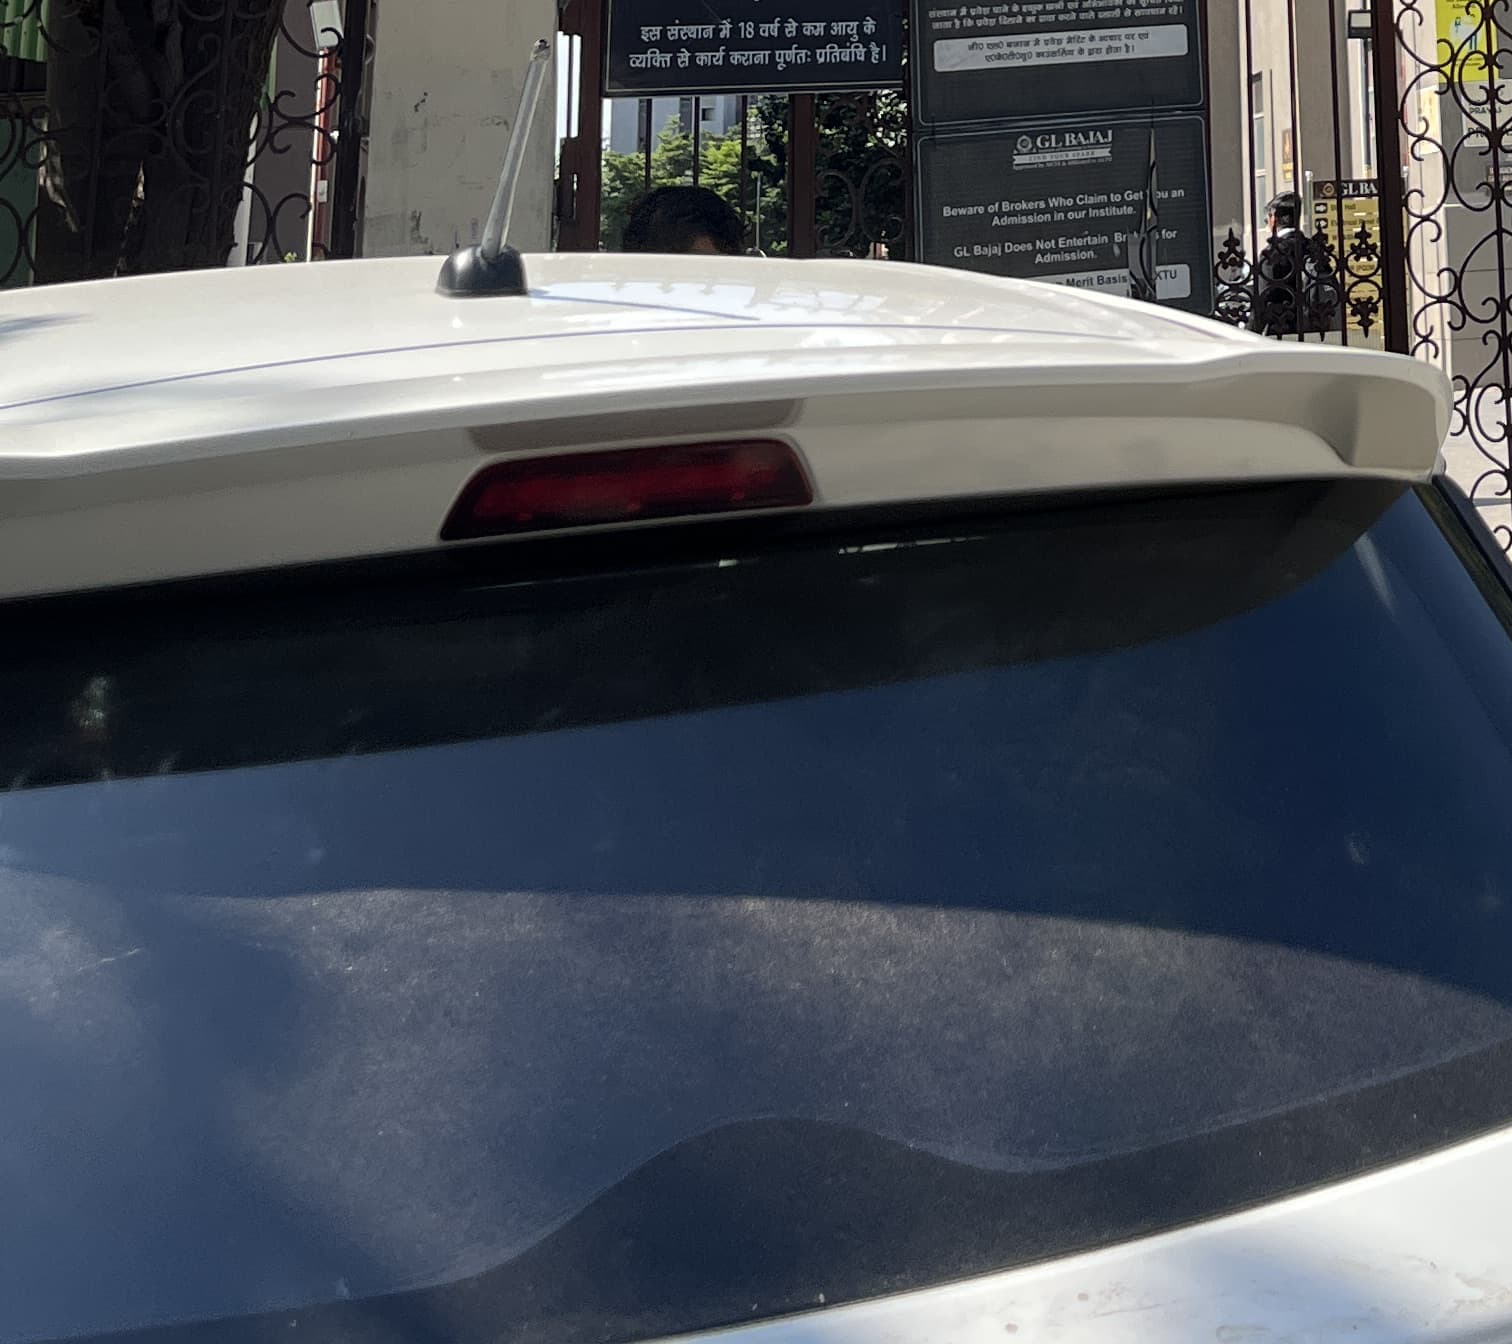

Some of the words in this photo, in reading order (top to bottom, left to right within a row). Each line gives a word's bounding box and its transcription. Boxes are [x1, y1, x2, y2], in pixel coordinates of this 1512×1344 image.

[640, 25, 663, 42] इस
[666, 19, 716, 41] संस्थान
[718, 18, 733, 40] में
[738, 22, 755, 39] 18
[759, 17, 781, 38] वर्ष
[784, 18, 799, 38] से
[802, 22, 826, 37] कम
[830, 20, 859, 41] आयु
[862, 16, 877, 36] के
[629, 48, 673, 69] व्यक्ति
[677, 48, 692, 68] से
[695, 46, 726, 66] कार्य
[729, 51, 770, 65] कराना
[1036, 134, 1062, 148] GL
[1064, 130, 1112, 146] BAJAJ
[943, 202, 984, 217] Beware
[988, 201, 999, 213] of
[1002, 197, 1046, 212] Brokers
[1048, 196, 1074, 209] Who
[1076, 192, 1107, 206] Claim
[1110, 192, 1121, 203] to
[1124, 190, 1143, 202] Get
[1171, 189, 1185, 198] an
[992, 210, 1051, 227] Admission
[1053, 210, 1064, 221] in
[1067, 209, 1086, 220] our
[1088, 204, 1136, 218] Institute.
[954, 245, 971, 257] GL
[973, 243, 1001, 257] Bajaj
[1004, 240, 1033, 253] Does
[1036, 238, 1056, 250] Not
[1058, 234, 1108, 249] Entertain
[1162, 229, 1177, 240] for
[1035, 249, 1098, 264] Admission.
[1066, 277, 1093, 289] Merit
[1097, 274, 1128, 285] Basis
